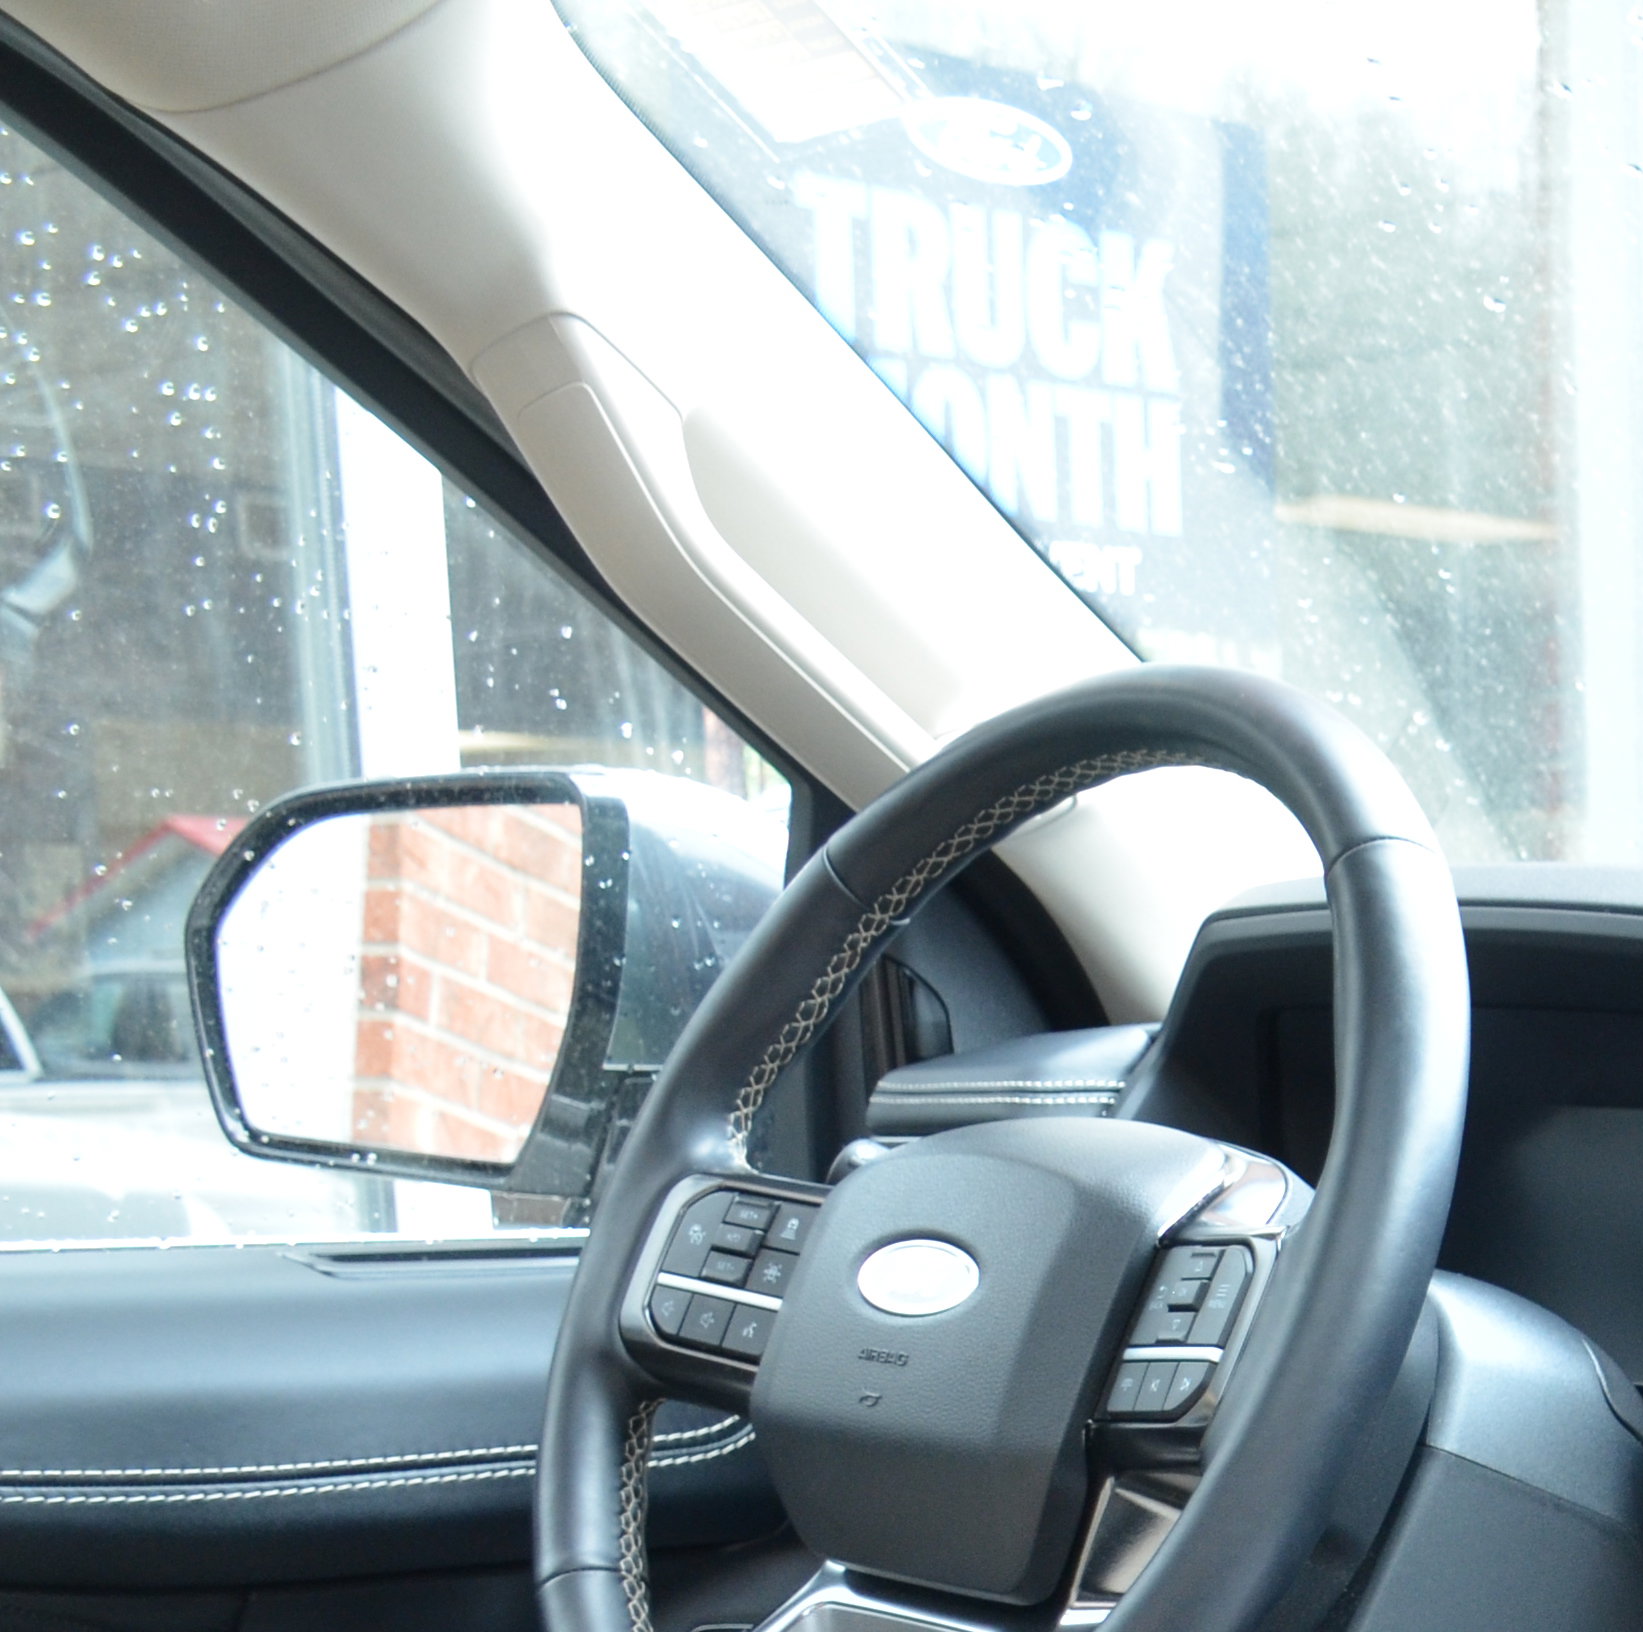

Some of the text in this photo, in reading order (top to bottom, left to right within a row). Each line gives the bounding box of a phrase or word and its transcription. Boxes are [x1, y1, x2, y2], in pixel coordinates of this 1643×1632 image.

[790, 171, 1181, 394] TRUCK
[867, 352, 1184, 539] ONTH
[857, 1347, 910, 1367] AIRBAG
